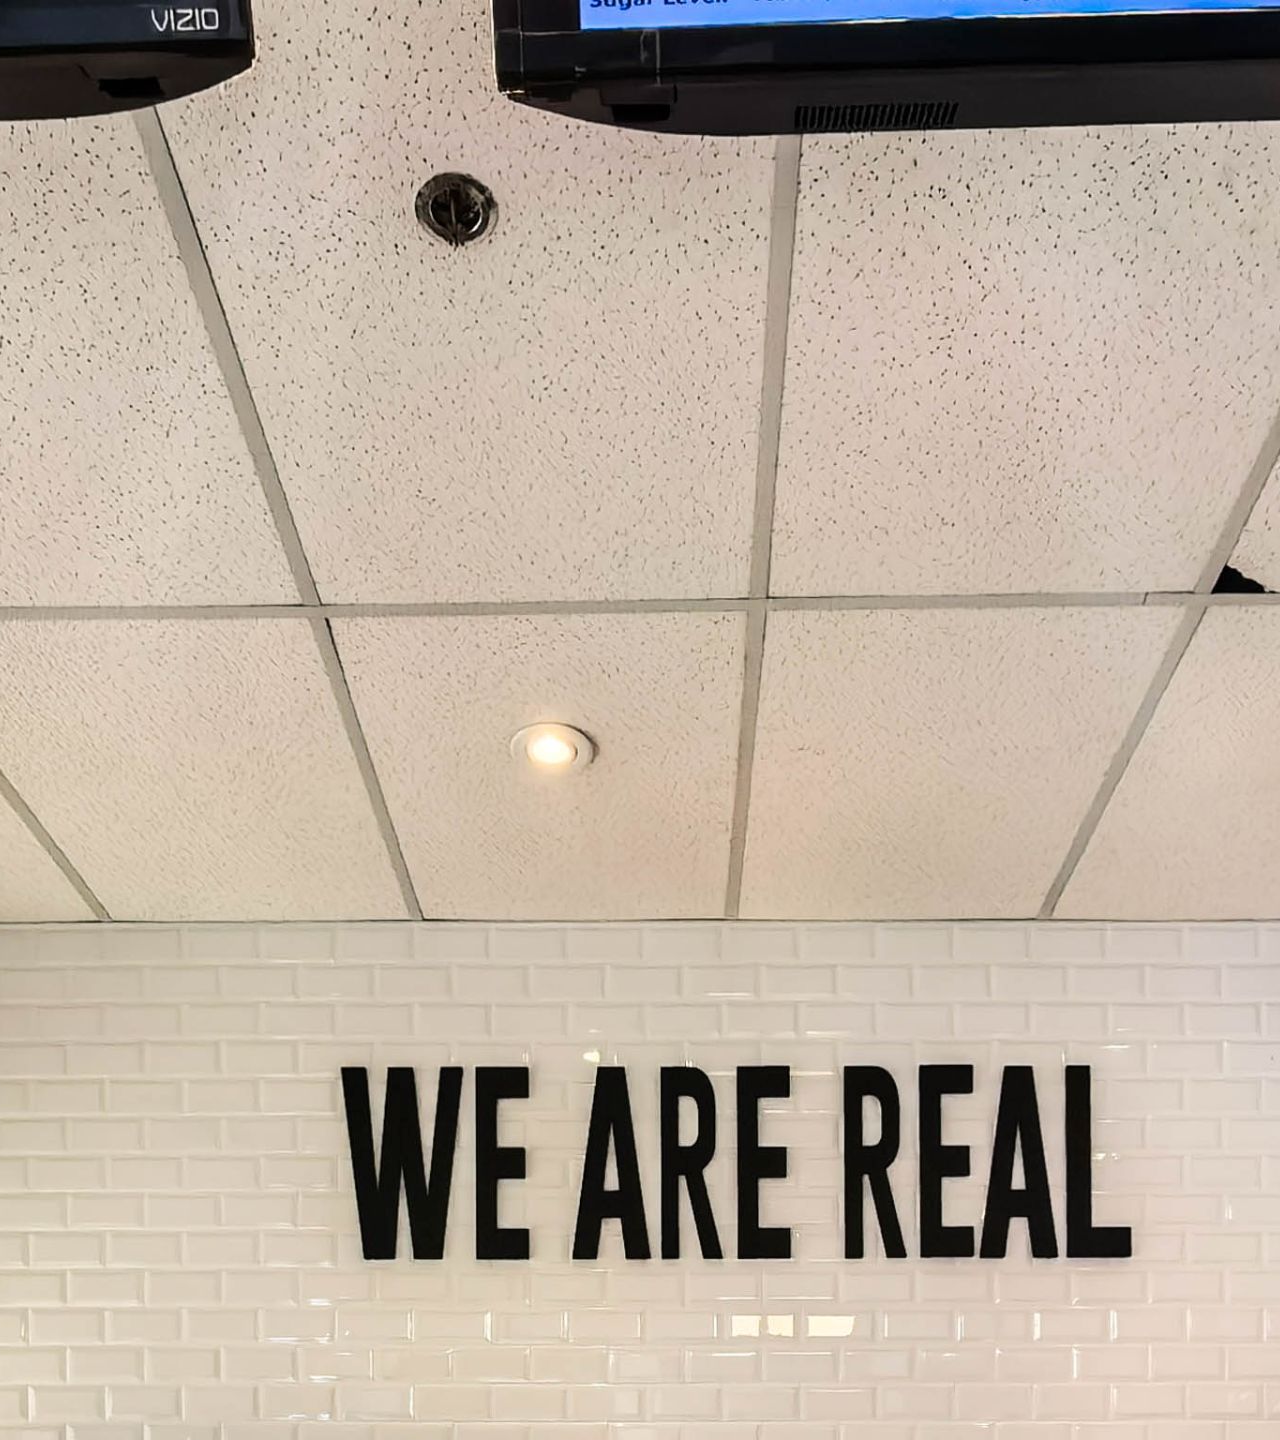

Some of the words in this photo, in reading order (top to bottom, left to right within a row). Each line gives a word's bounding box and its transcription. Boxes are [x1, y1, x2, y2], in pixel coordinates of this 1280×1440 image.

[151, 8, 219, 32] VIZIO
[341, 1065, 530, 1260] WE
[572, 1065, 793, 1260] ARE
[844, 1064, 1132, 1259] REAL
